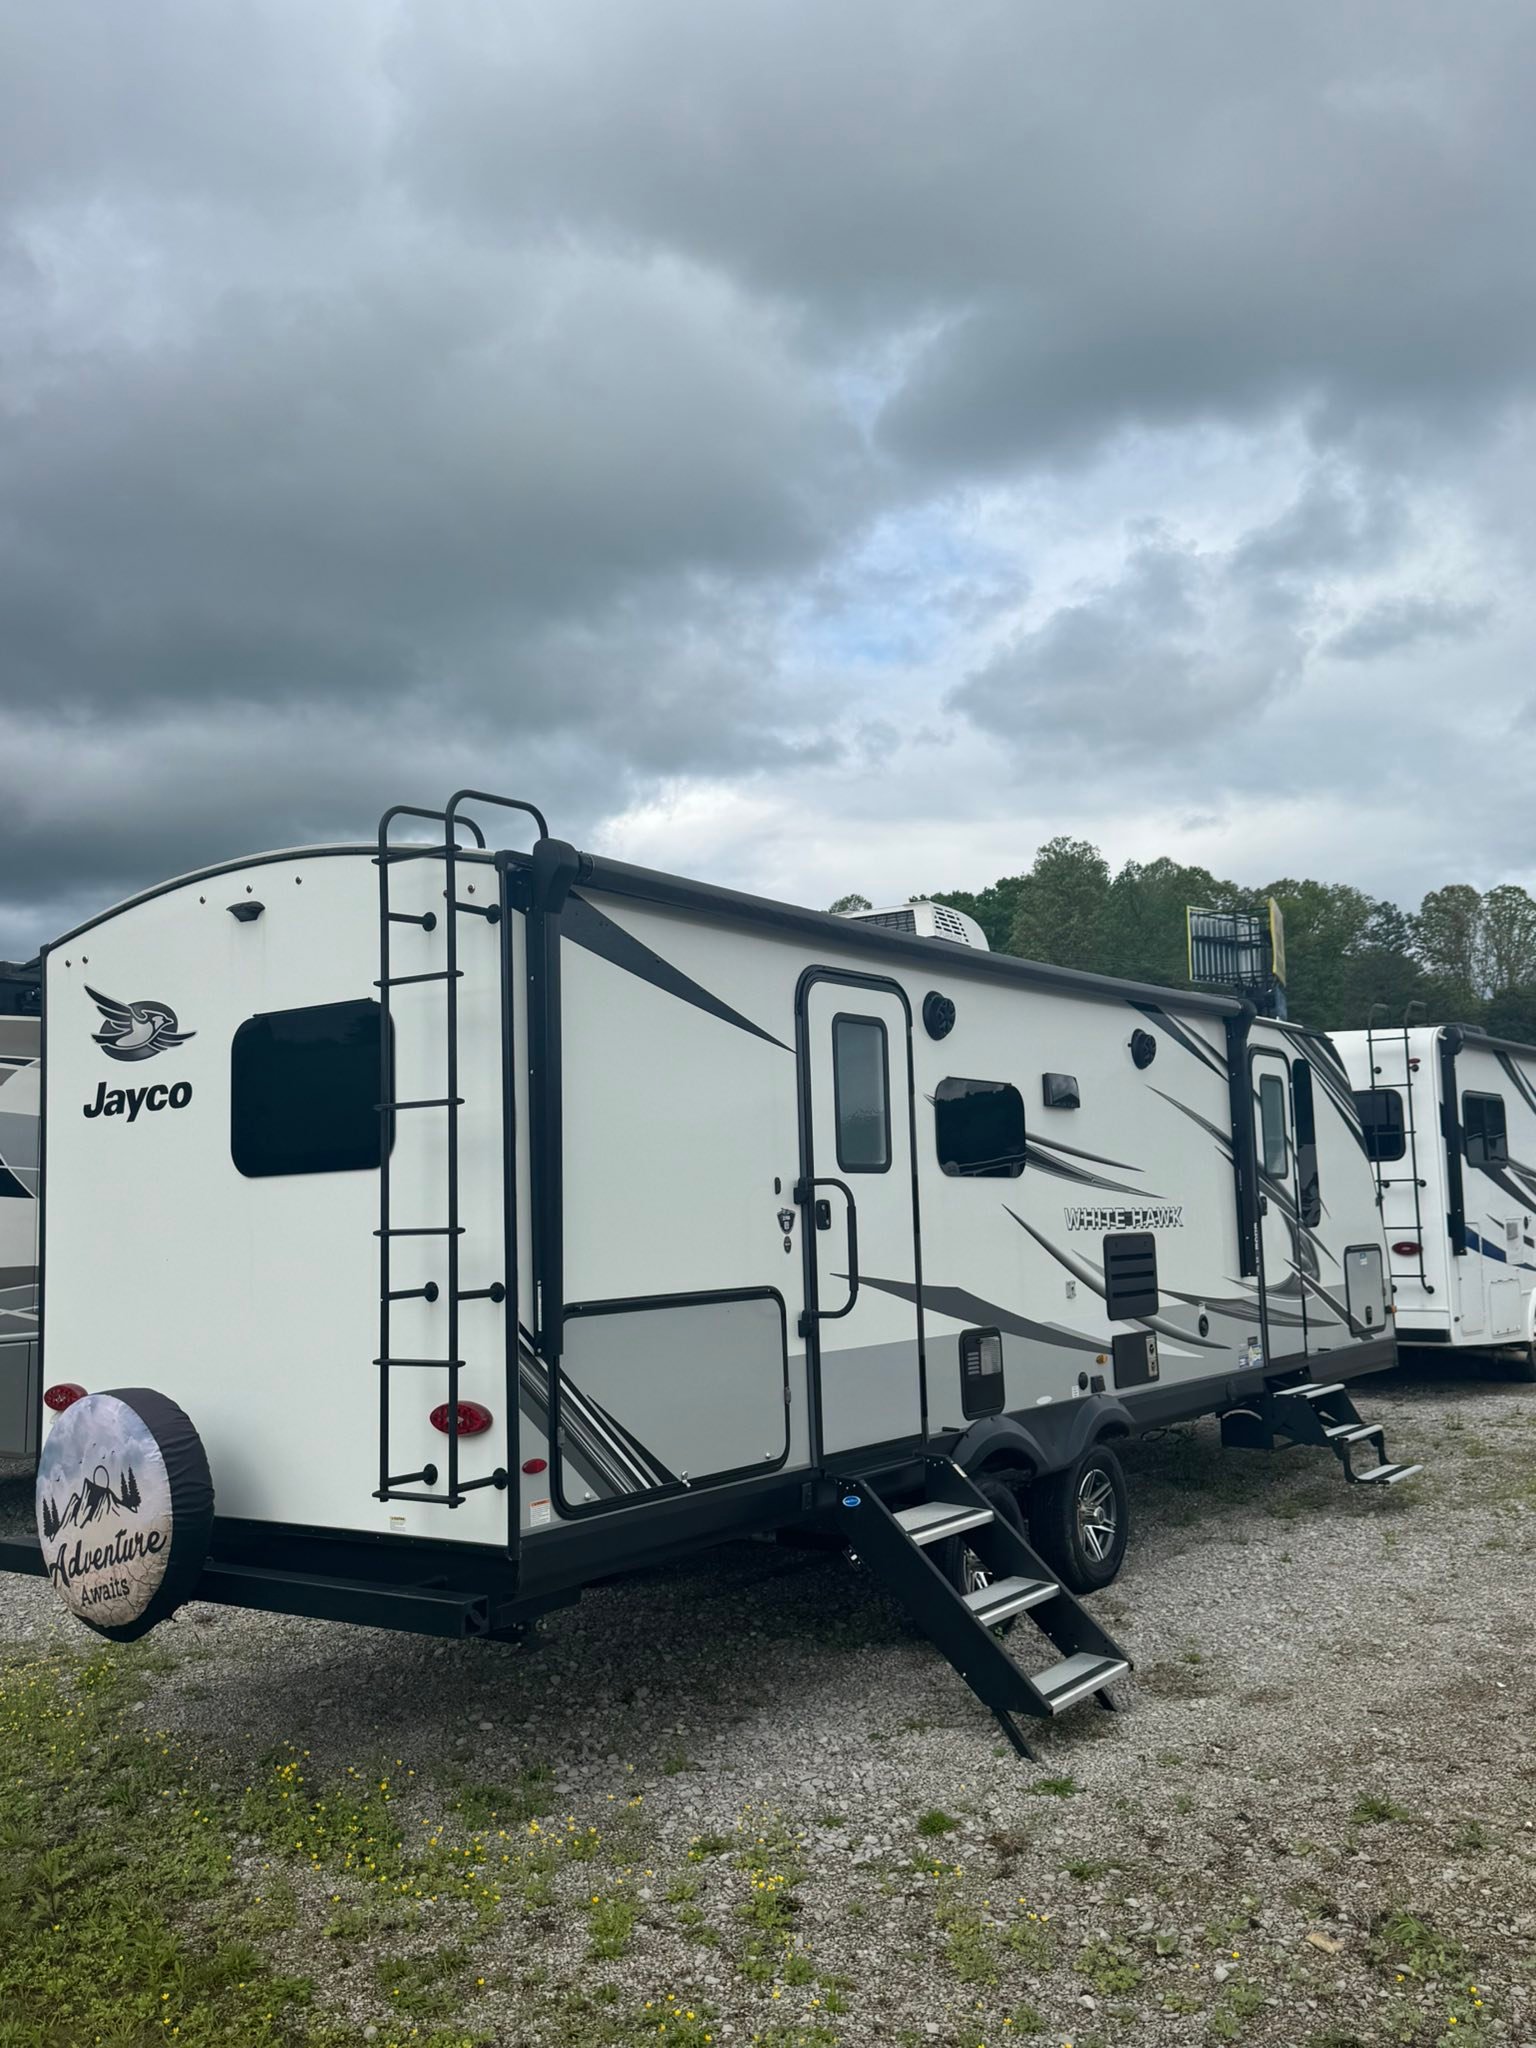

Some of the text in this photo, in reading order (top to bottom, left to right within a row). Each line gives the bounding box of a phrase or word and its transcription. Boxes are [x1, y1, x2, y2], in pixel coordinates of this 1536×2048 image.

[83, 1081, 193, 1123] Jayco
[1064, 1206, 1184, 1231] WHITE HAWK
[48, 1528, 168, 1590] Adventure
[81, 1577, 131, 1607] Awaits
